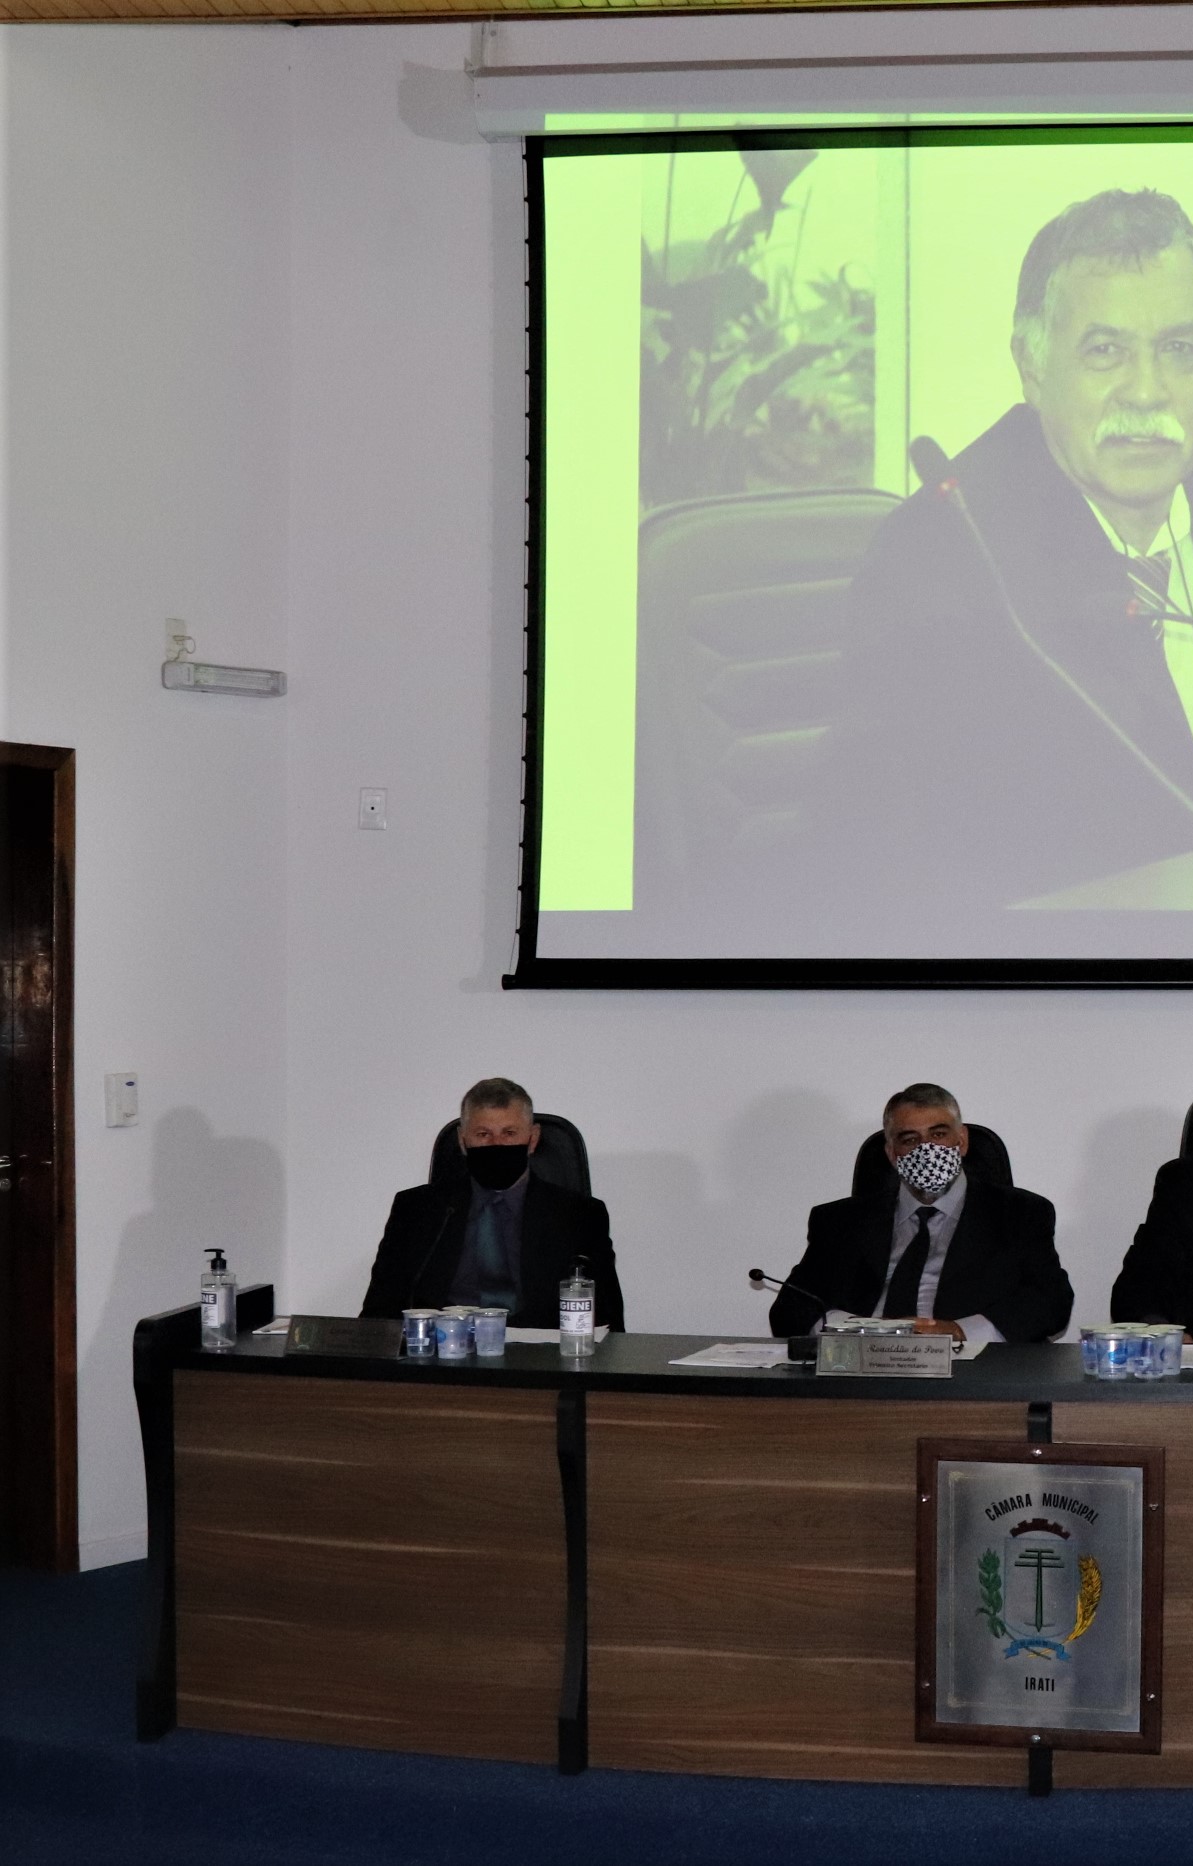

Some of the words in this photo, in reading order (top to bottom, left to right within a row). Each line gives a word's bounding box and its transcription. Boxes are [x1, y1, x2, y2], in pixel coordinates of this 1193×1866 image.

[985, 1493, 1032, 1521] CÂMARA
[1042, 1493, 1099, 1525] MUNICIPAL
[1025, 1676, 1055, 1692] IRATI
